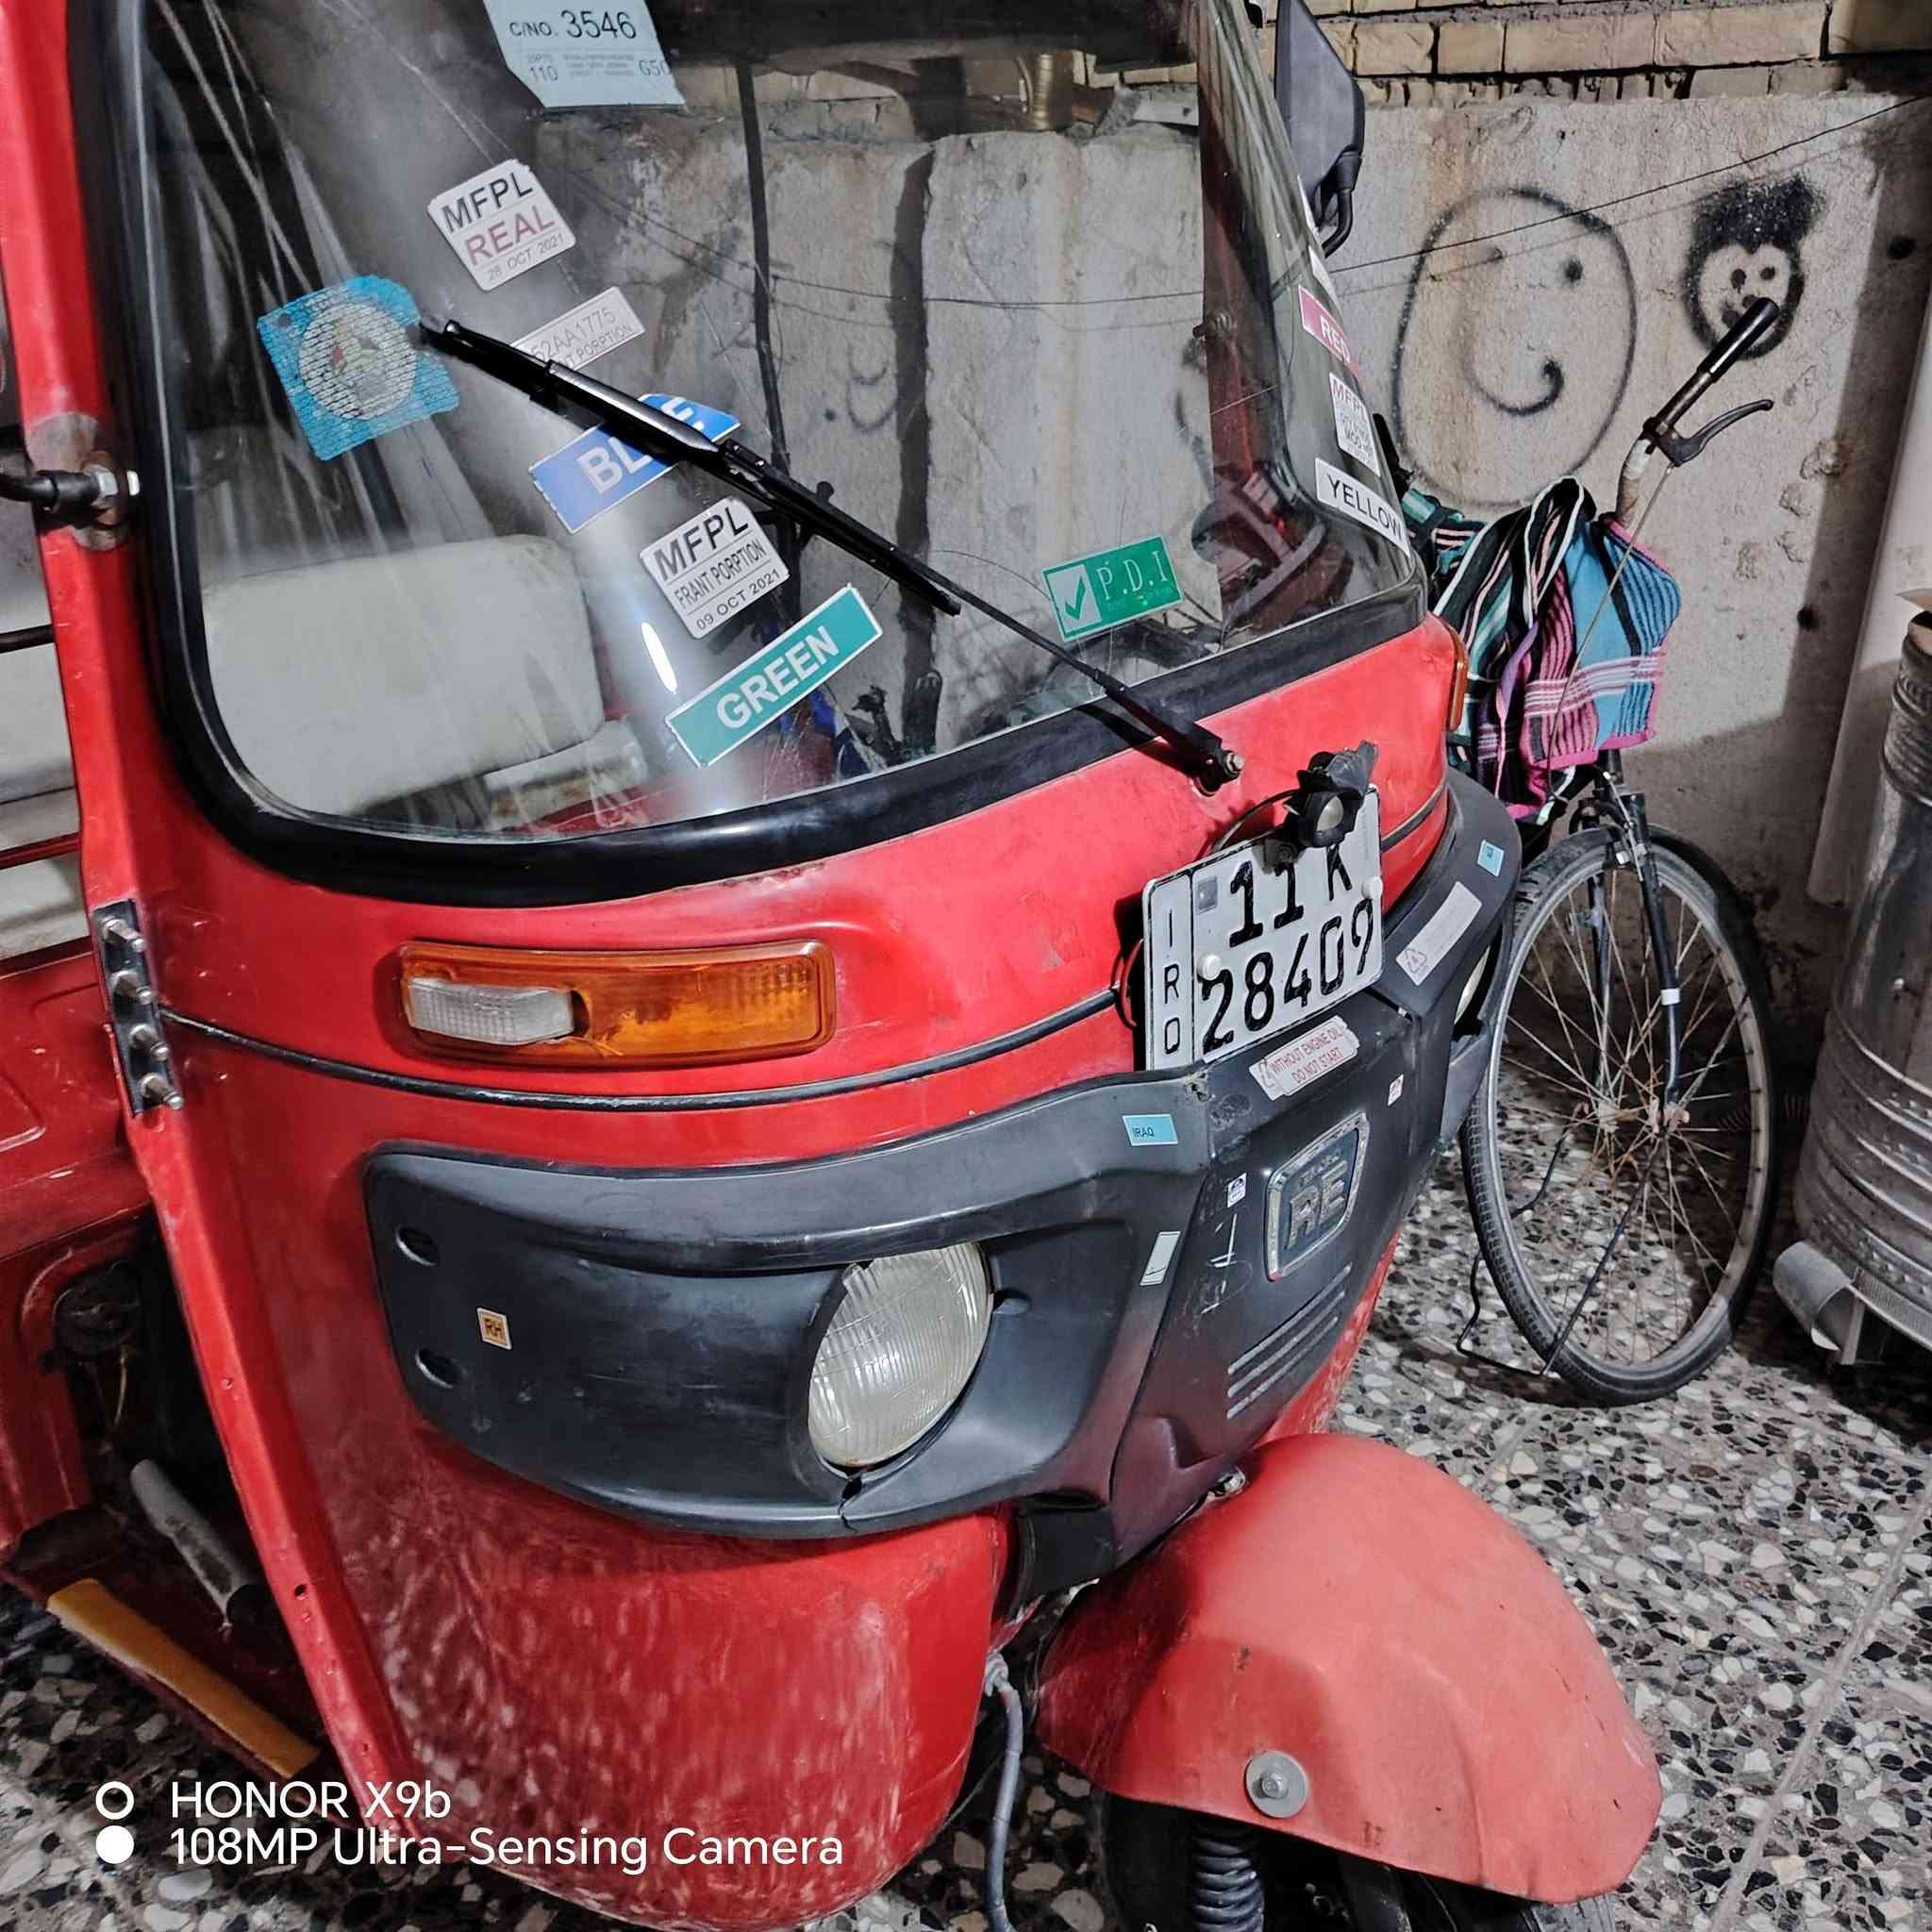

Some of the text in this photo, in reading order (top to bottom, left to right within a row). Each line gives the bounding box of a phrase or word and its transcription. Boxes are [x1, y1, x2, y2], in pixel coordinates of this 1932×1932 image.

[560, 9, 637, 39] 3546
[529, 65, 558, 81] 110
[441, 172, 533, 233] MFPL
[466, 205, 556, 265] REAL
[508, 249, 532, 270] OCT
[537, 234, 564, 254] 2021
[1321, 315, 1351, 364] RED
[653, 507, 749, 581] MFPL
[675, 538, 768, 609] FRANT PORPTION
[696, 568, 781, 631] 09 OCT 2021
[716, 625, 840, 728] GREEN
[1229, 860, 1305, 947] 11
[1198, 899, 1374, 1055] 28409
[1267, 1047, 1306, 1074] WITHOUT
[1305, 1031, 1331, 1055] ENGINE
[1291, 1046, 1344, 1084] DO NOT START
[1132, 1126, 1156, 1138] IRAQ
